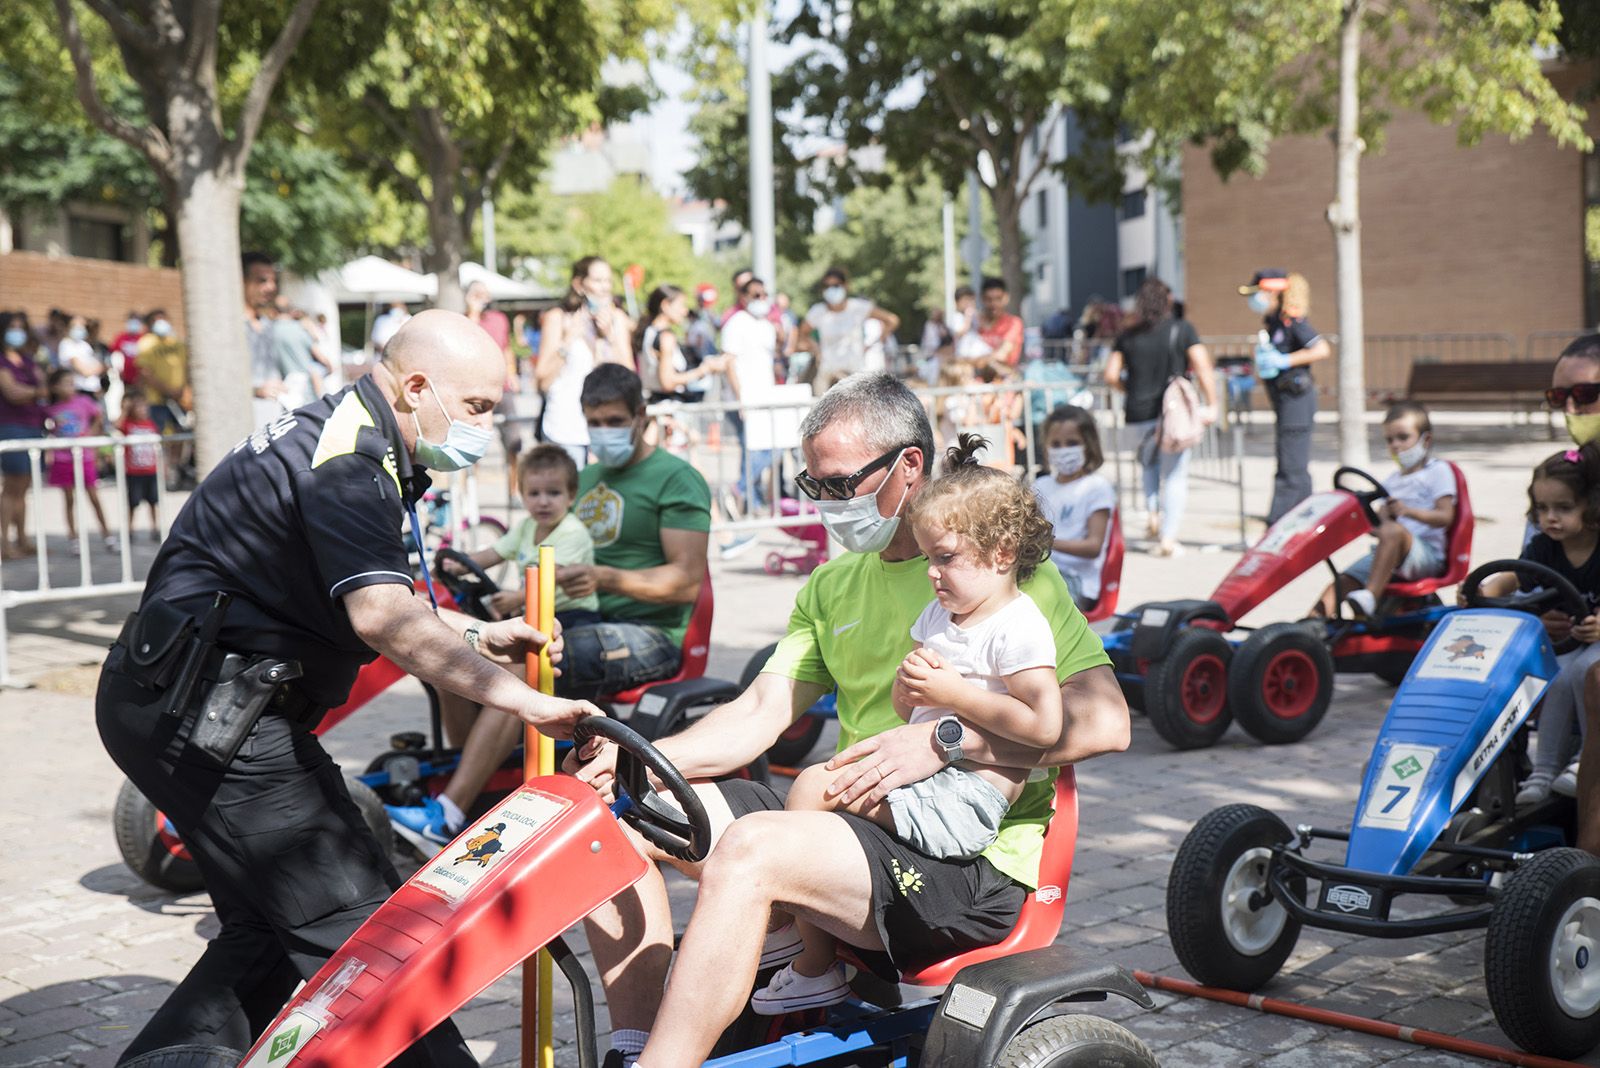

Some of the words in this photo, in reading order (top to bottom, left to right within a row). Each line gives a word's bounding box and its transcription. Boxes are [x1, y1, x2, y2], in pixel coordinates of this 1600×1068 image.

[1473, 735, 1498, 771] EXTRA
[1501, 699, 1522, 738] SPORT
[1380, 784, 1411, 814] 7
[518, 815, 537, 828] LOCAL
[890, 858, 908, 897] KELME
[1328, 889, 1370, 909] BERG
